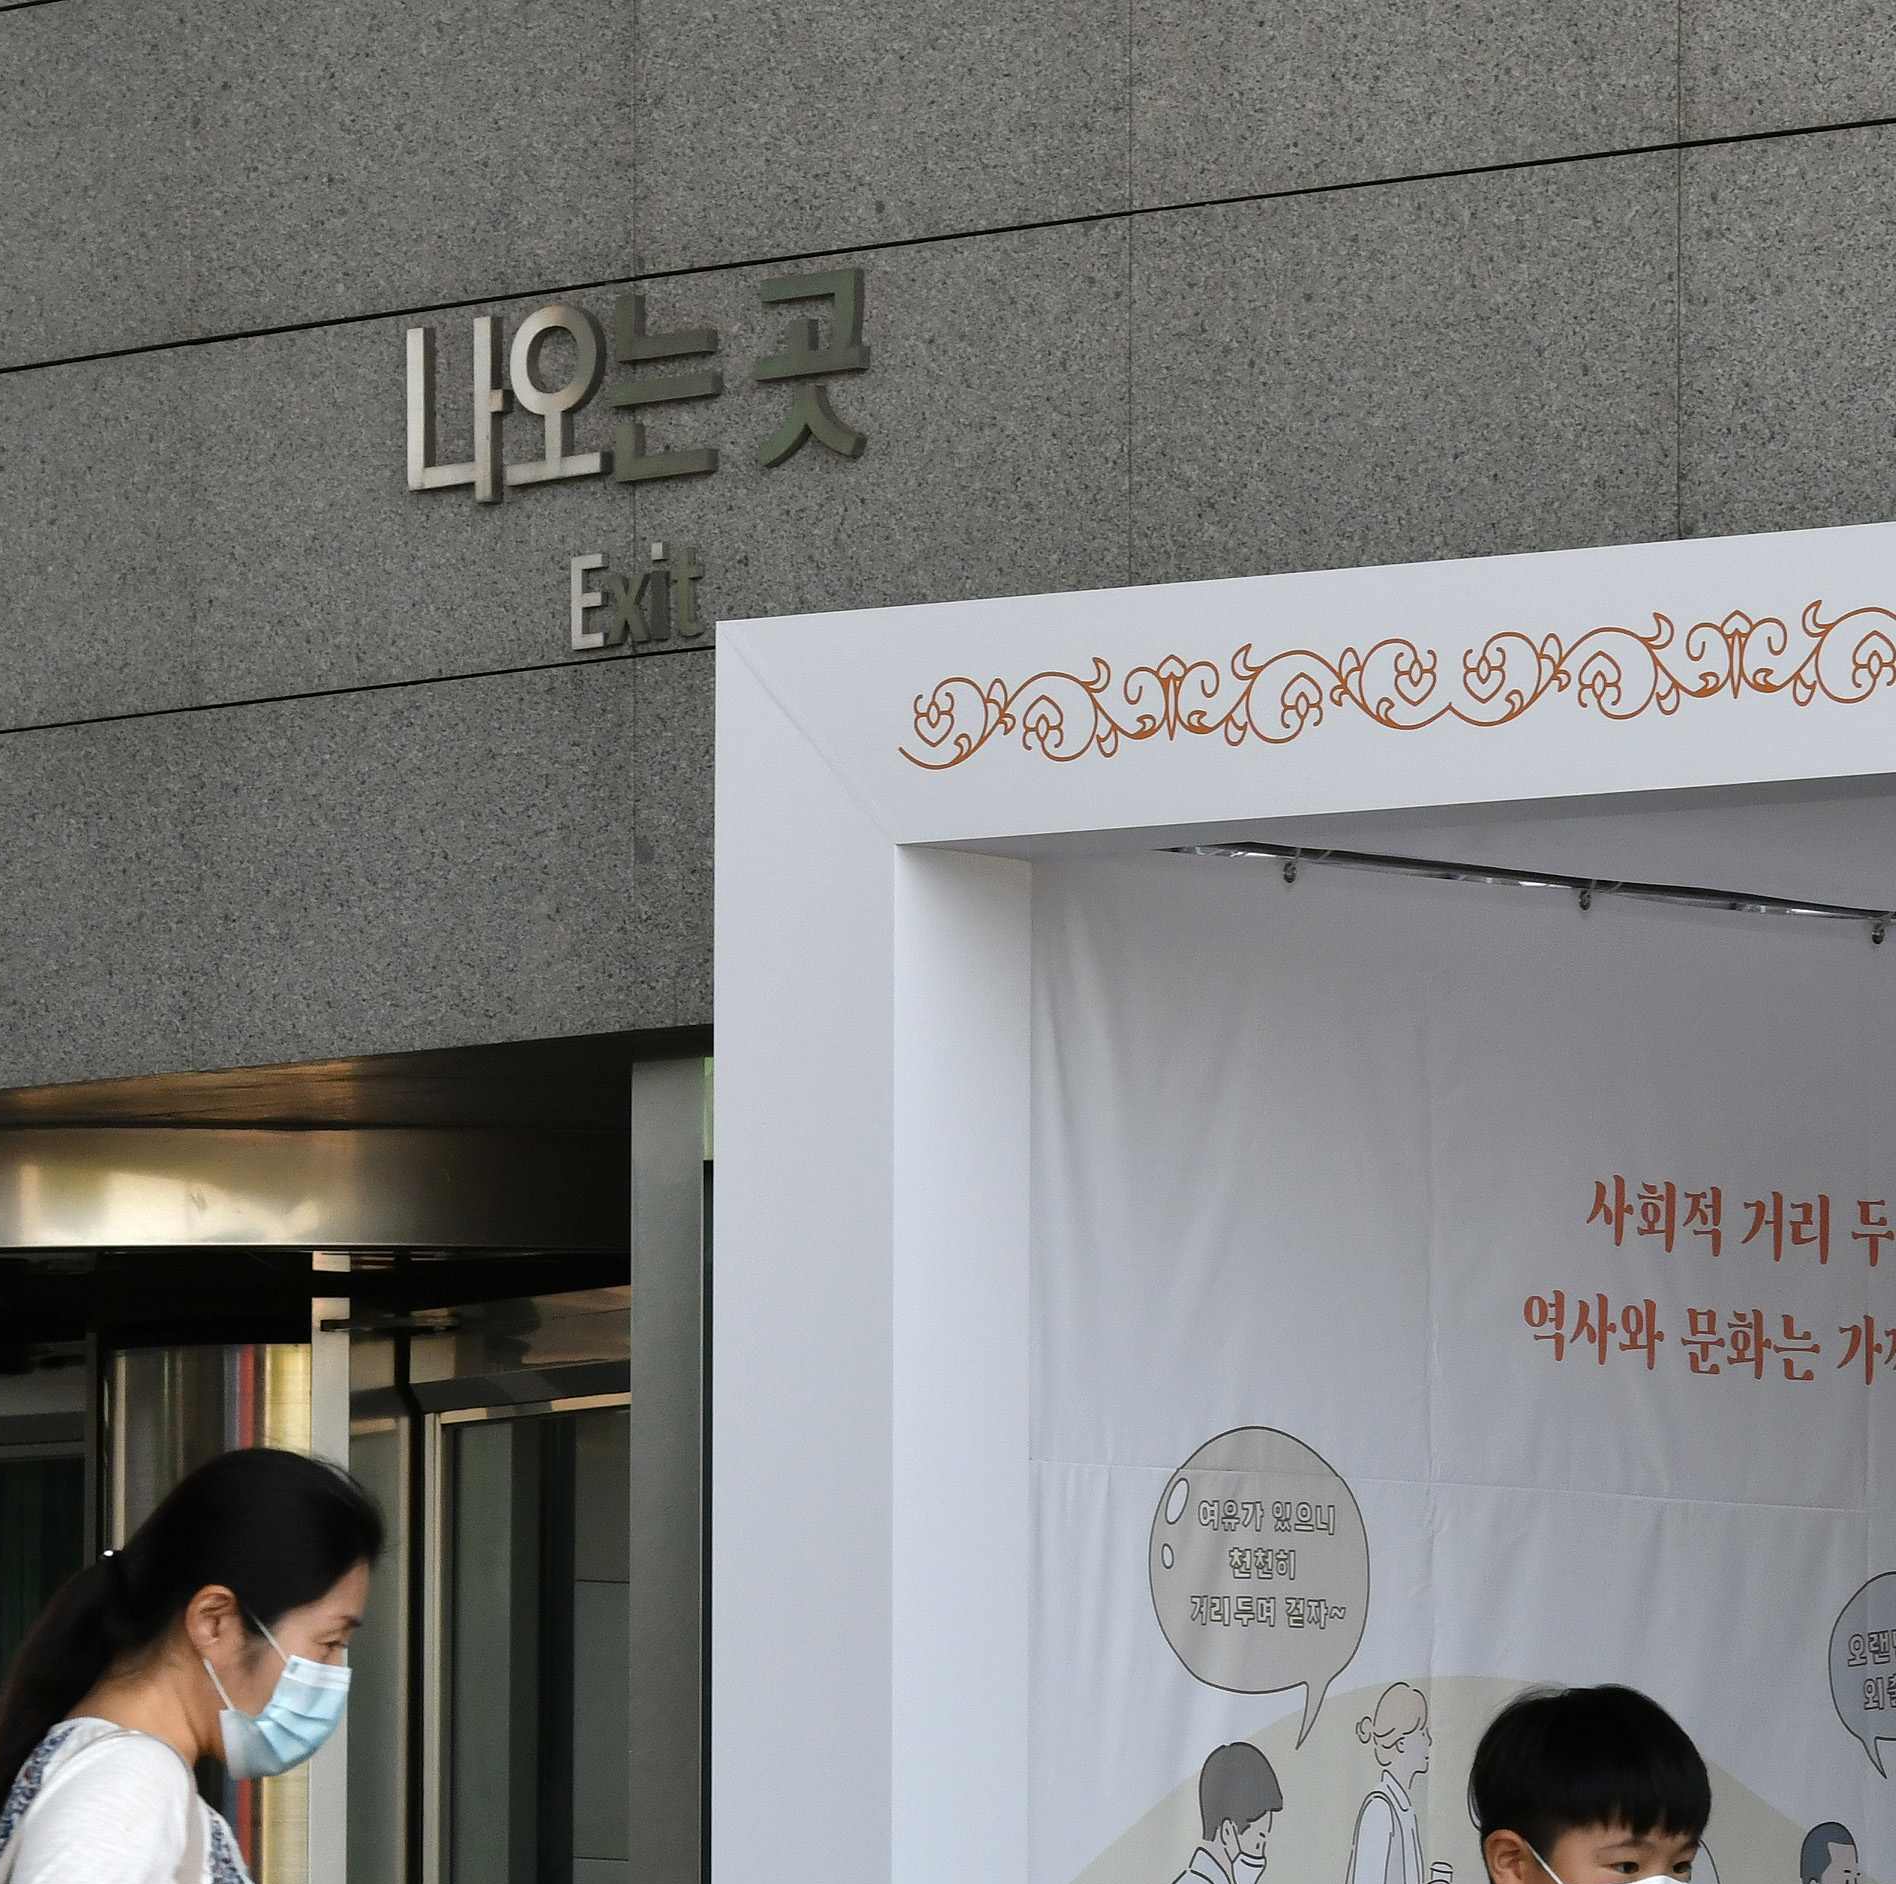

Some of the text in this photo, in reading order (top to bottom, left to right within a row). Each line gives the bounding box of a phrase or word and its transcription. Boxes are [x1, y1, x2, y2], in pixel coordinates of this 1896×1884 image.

[406, 268, 871, 503] 나오는 곳
[570, 541, 705, 651] Exit
[1586, 1174, 1723, 1257] 사회적
[1741, 1190, 1830, 1265] 거리
[1522, 1289, 1665, 1370] 역사와
[1680, 1307, 1821, 1381] 문화는
[1198, 1500, 1336, 1535] 여유가 있으니
[1228, 1546, 1296, 1581] 천천히
[1190, 1594, 1277, 1628] 거리두며
